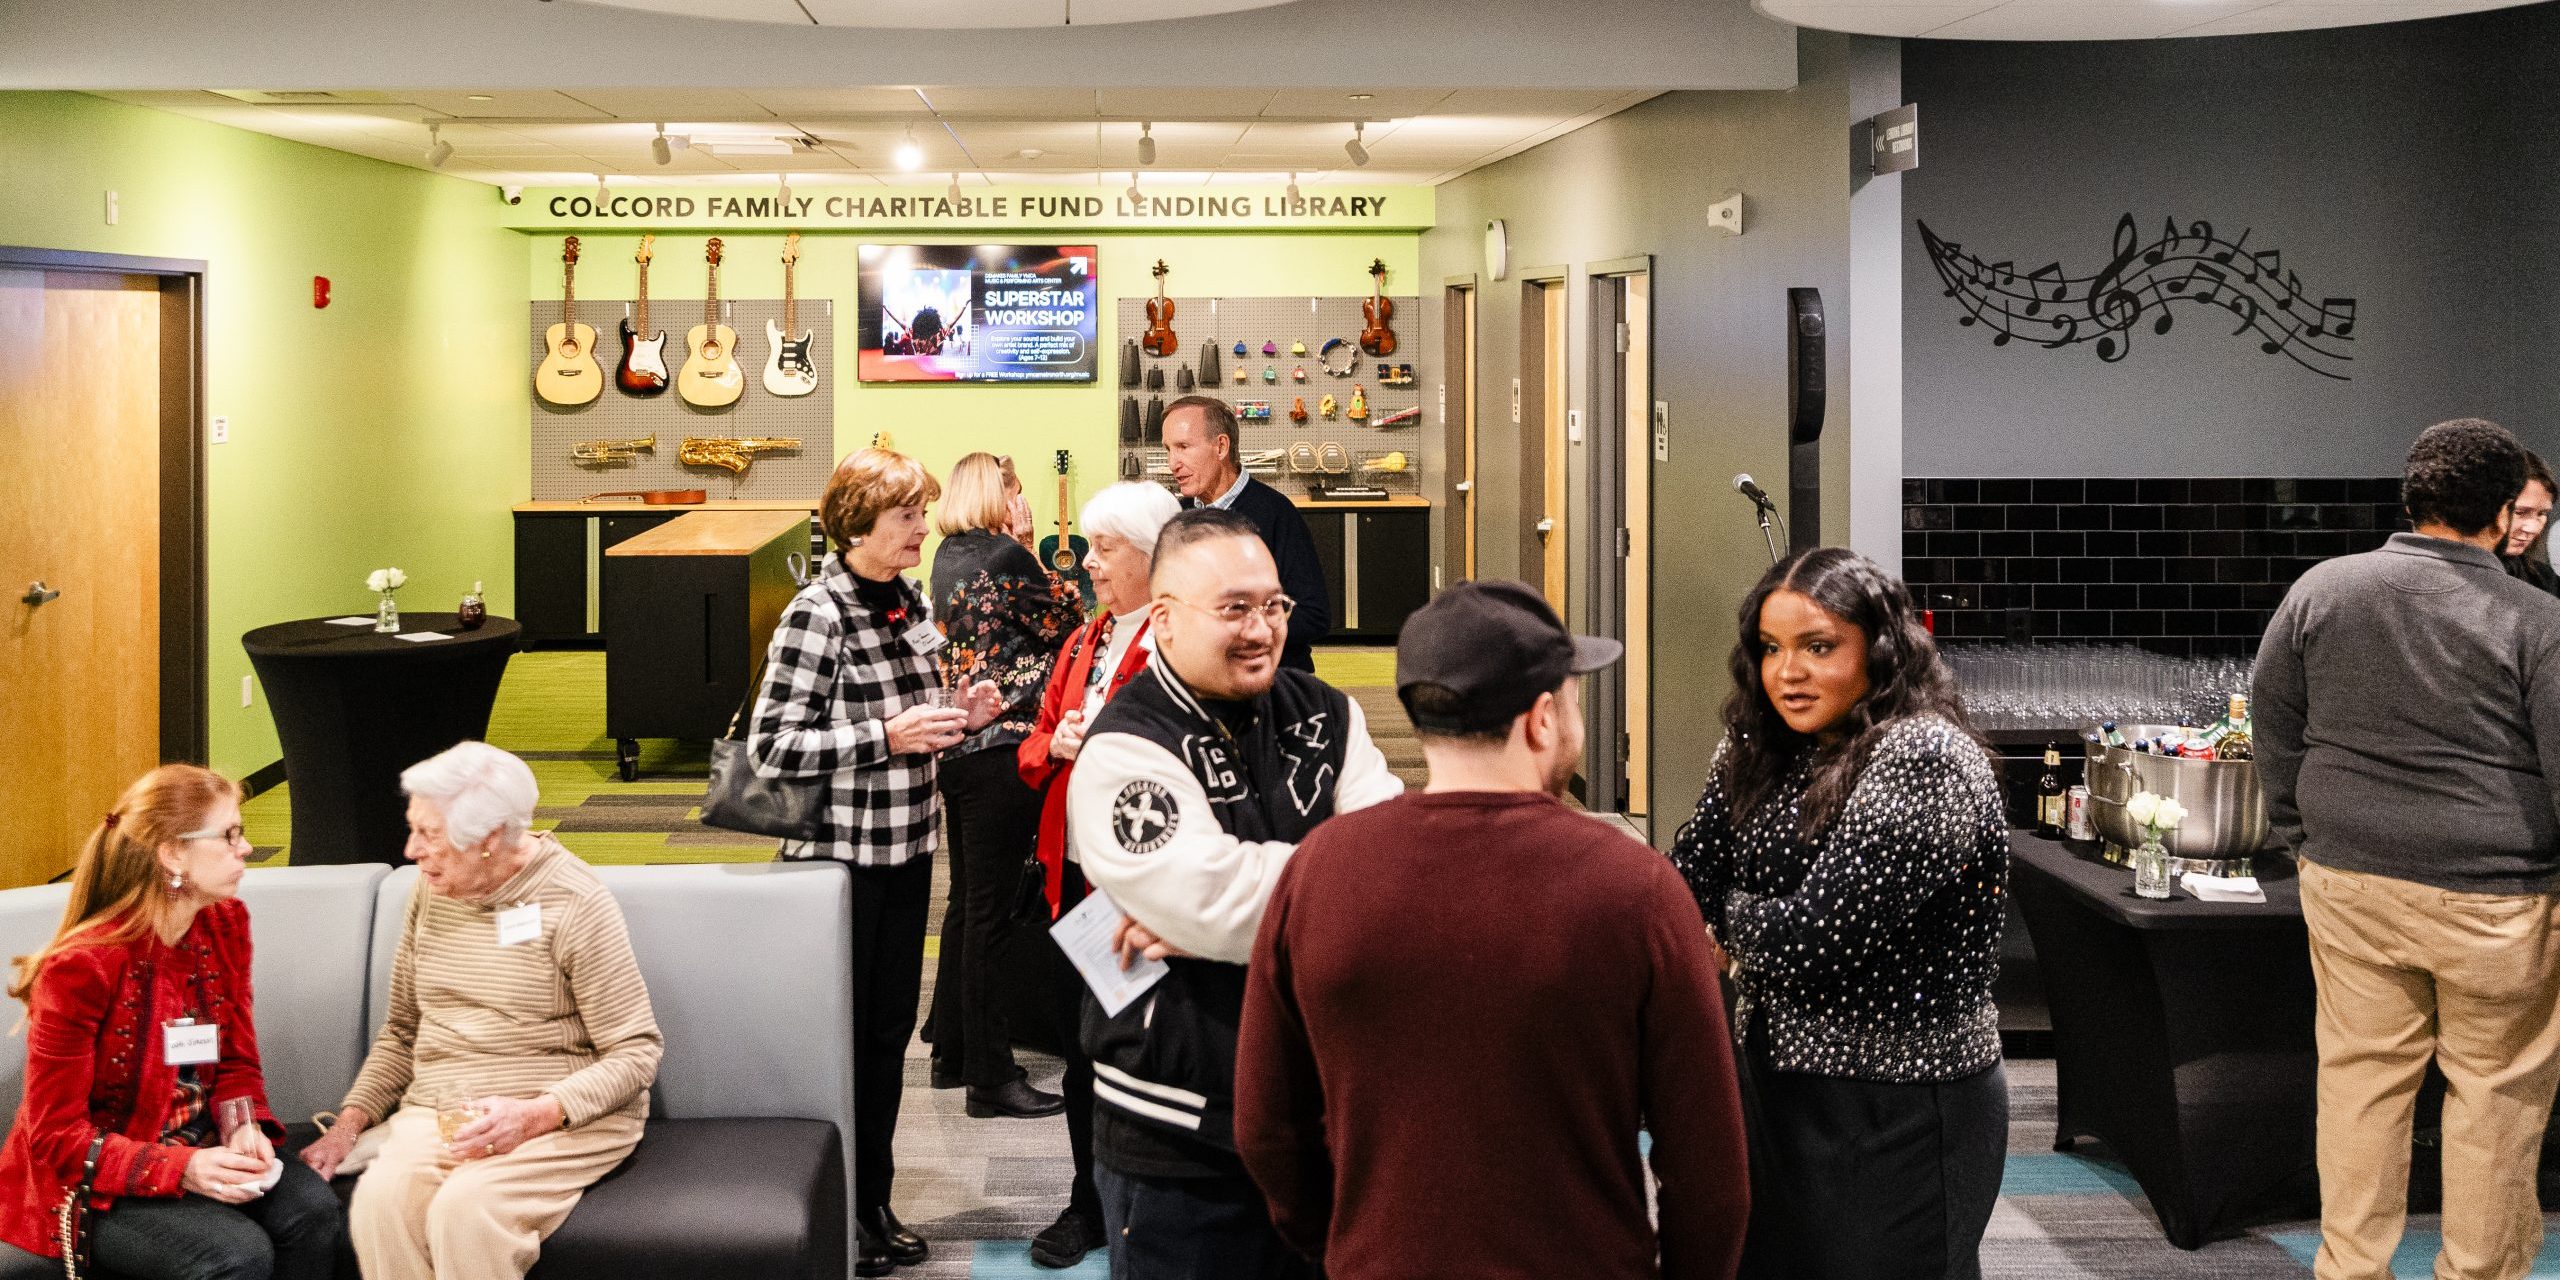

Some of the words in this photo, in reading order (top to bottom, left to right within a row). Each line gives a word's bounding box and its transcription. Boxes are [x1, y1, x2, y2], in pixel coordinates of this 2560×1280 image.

[549, 196, 695, 218] COLCORD
[708, 197, 814, 218] FAMILY
[825, 196, 1007, 218] CHARITABLE
[1021, 196, 1104, 218] FUND
[1117, 196, 1251, 218] LENDING
[1264, 196, 1387, 218] LIBRARY
[985, 290, 1085, 307] SUPERSTAR
[985, 310, 1085, 326] WORKSHOP
